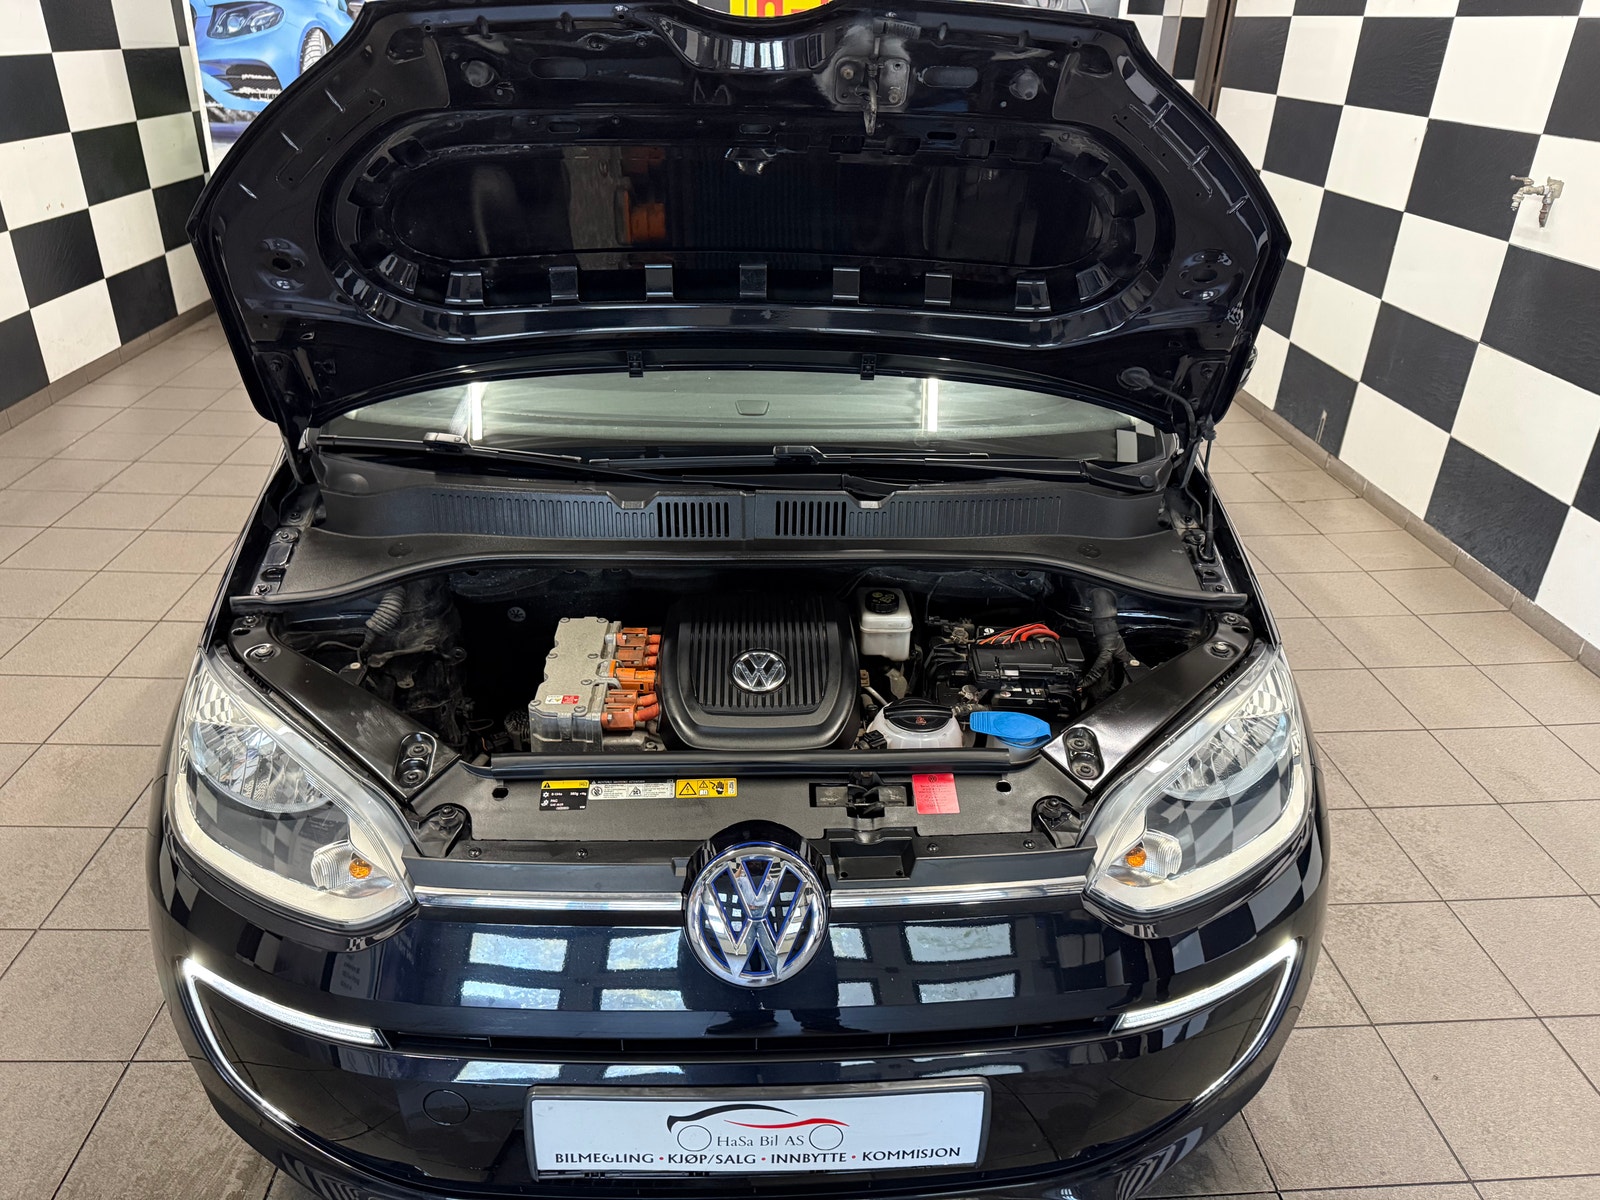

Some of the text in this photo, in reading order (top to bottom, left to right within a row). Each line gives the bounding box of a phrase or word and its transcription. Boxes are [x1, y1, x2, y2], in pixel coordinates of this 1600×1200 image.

[692, 849, 822, 983] VW
[717, 1134, 805, 1148] HaSa Bil AS
[555, 1146, 962, 1165] BILMEGLING KJØP/SALG INNBYTTE KOMMISJON
